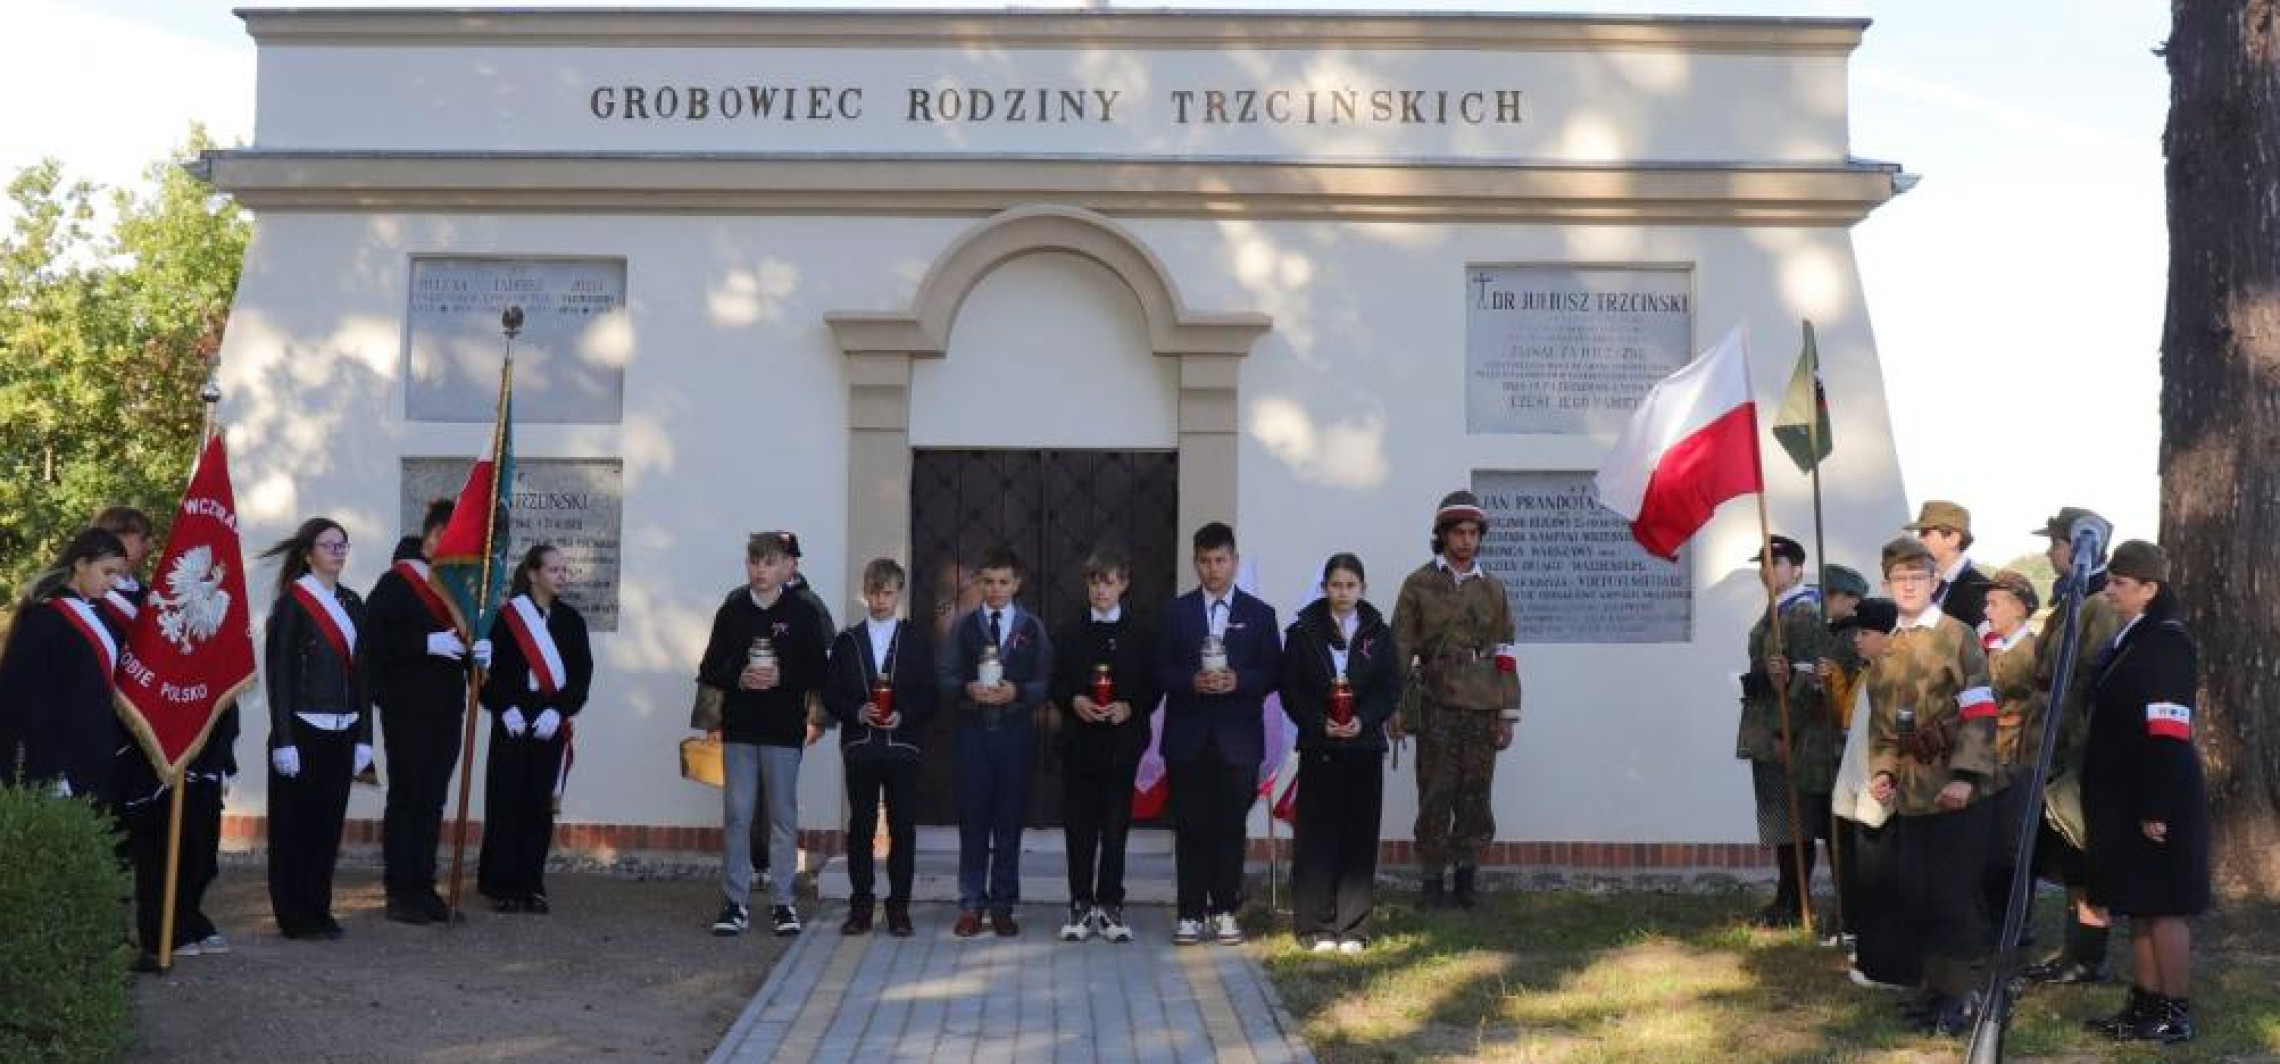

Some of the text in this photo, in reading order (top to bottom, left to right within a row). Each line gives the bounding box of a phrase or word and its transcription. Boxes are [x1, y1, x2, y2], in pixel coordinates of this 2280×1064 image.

[589, 87, 1525, 124] GROBOWIEC RODZINY TRZCIŃSKICH
[1492, 290, 1688, 313] DR JULIUSZ TRZCIŃSKI
[160, 682, 208, 703] POLSKO
